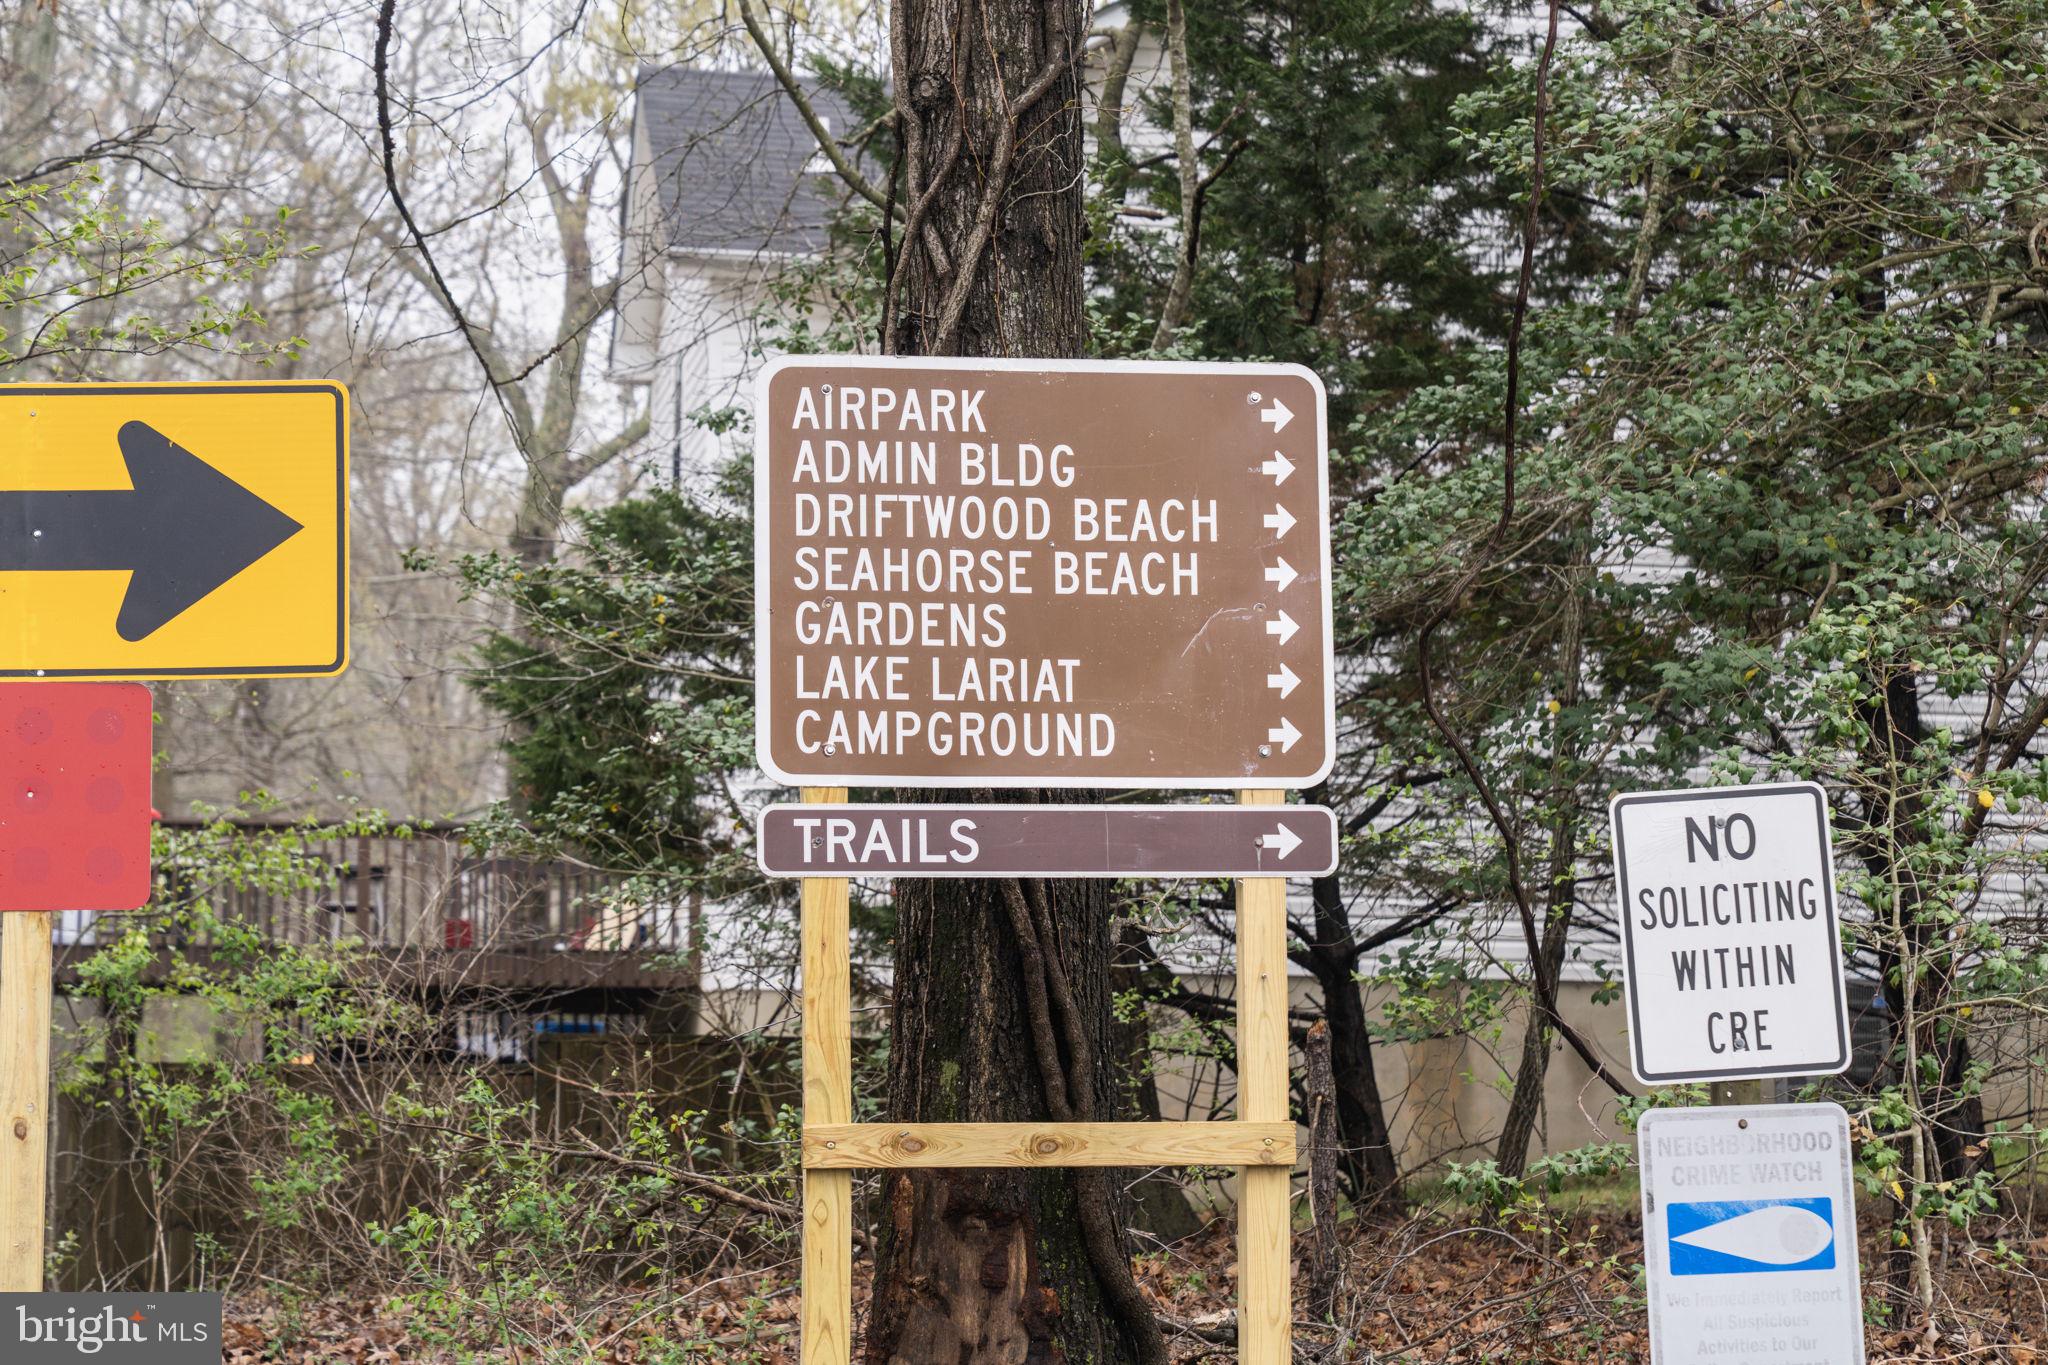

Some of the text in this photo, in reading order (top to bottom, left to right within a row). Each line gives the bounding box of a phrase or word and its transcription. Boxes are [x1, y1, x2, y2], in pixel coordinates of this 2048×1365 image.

[792, 387, 987, 433] AIRPARK
[792, 440, 1075, 488] ADMIN BLDG
[795, 494, 1218, 543] DRIFTWOOD BEACH
[793, 547, 1199, 596] SEAHORSE BEACH
[795, 601, 1007, 648] GARDENS
[796, 656, 1081, 703] LAKE LARIAT
[795, 710, 1116, 757] CAMPGROUND
[793, 818, 980, 863] TRAILS
[1684, 812, 1756, 863] NO
[1638, 878, 1817, 931] SOLICITING
[1671, 944, 1796, 992] WITHIN
[1707, 1009, 1773, 1054] CRE
[1671, 1163, 1741, 1187] CRIME
[1750, 1160, 1823, 1184] WATCH
[1666, 1292, 1691, 1307] We
[1791, 1286, 1843, 1306] Report
[1696, 1335, 1819, 1355] Activities to Our
[1703, 1312, 1810, 1331] All Suspicious
